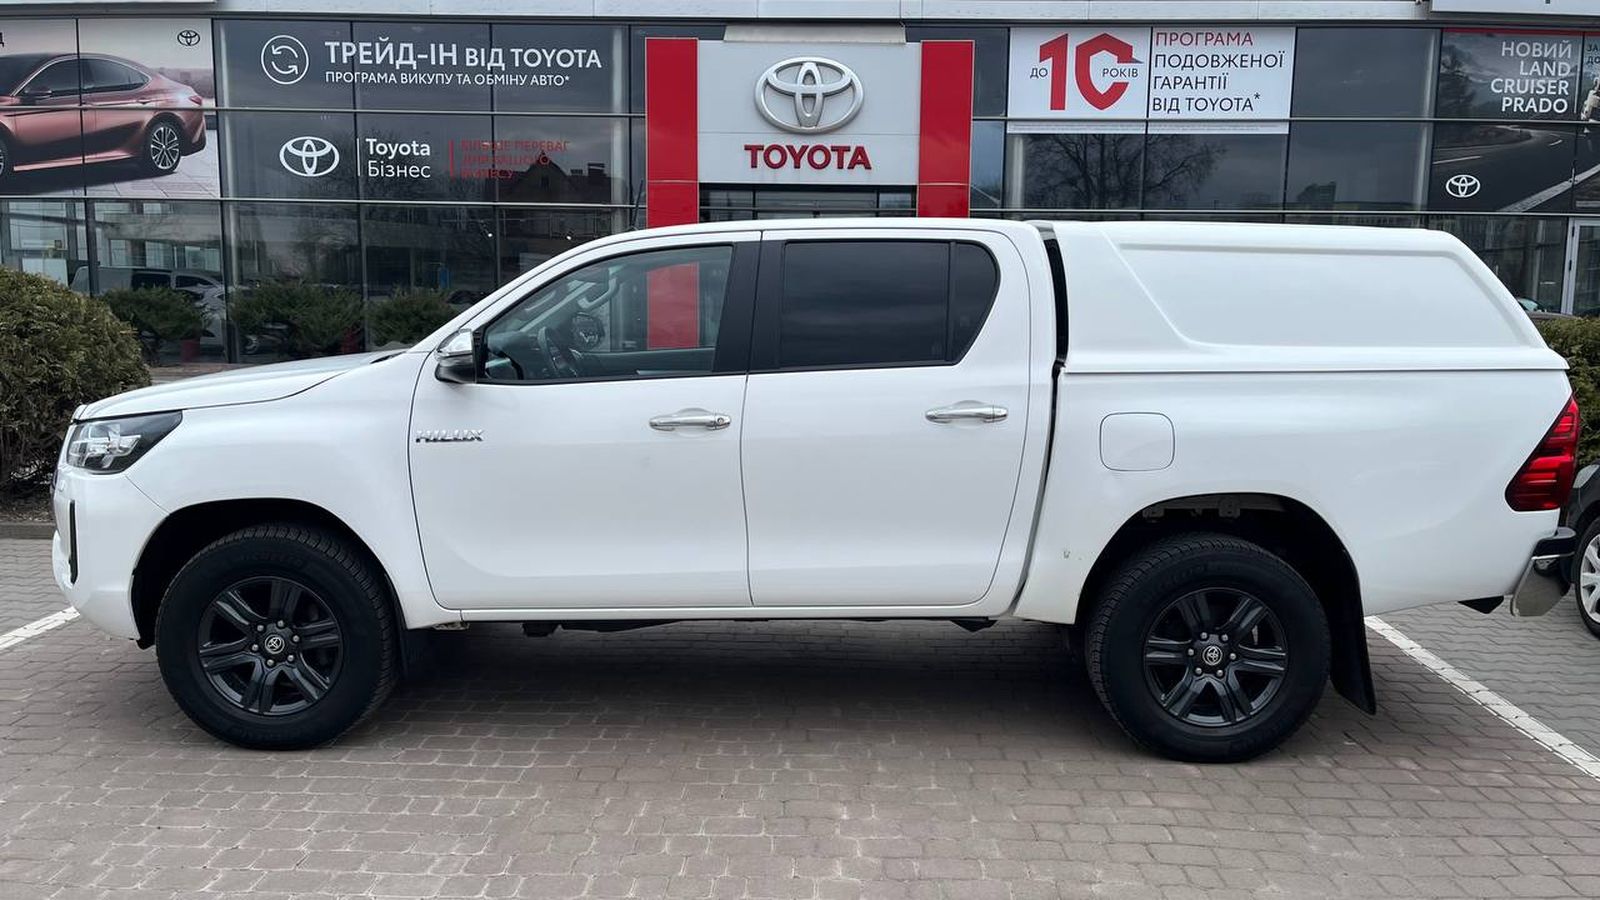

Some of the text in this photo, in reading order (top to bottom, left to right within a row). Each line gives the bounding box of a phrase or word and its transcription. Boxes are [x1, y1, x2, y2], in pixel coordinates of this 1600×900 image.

[1155, 31, 1253, 47] ПРОГРАМА
[324, 36, 602, 70] ТРЕЙД-ІН ВІД TOYOTA
[1501, 40, 1572, 59] НОВИЙ
[1154, 50, 1285, 71] ПОДОВЖЕНОЇ
[1519, 60, 1571, 77] LAND
[325, 71, 397, 84] ПРОГРАМА
[400, 72, 453, 85] ВИКУПУ
[456, 73, 472, 85] ТА
[474, 73, 527, 86] ОБМІНУ
[1029, 67, 1139, 79] ДО РОКІВ
[1153, 72, 1229, 90] ГАРАНТІЇ
[1490, 77, 1569, 96] CRUISER
[1152, 97, 1180, 115] ВІД
[1501, 96, 1568, 114] PRADO
[365, 138, 431, 160] Toyota
[743, 144, 872, 170] TOYOTA
[368, 160, 431, 178] Бізнес
